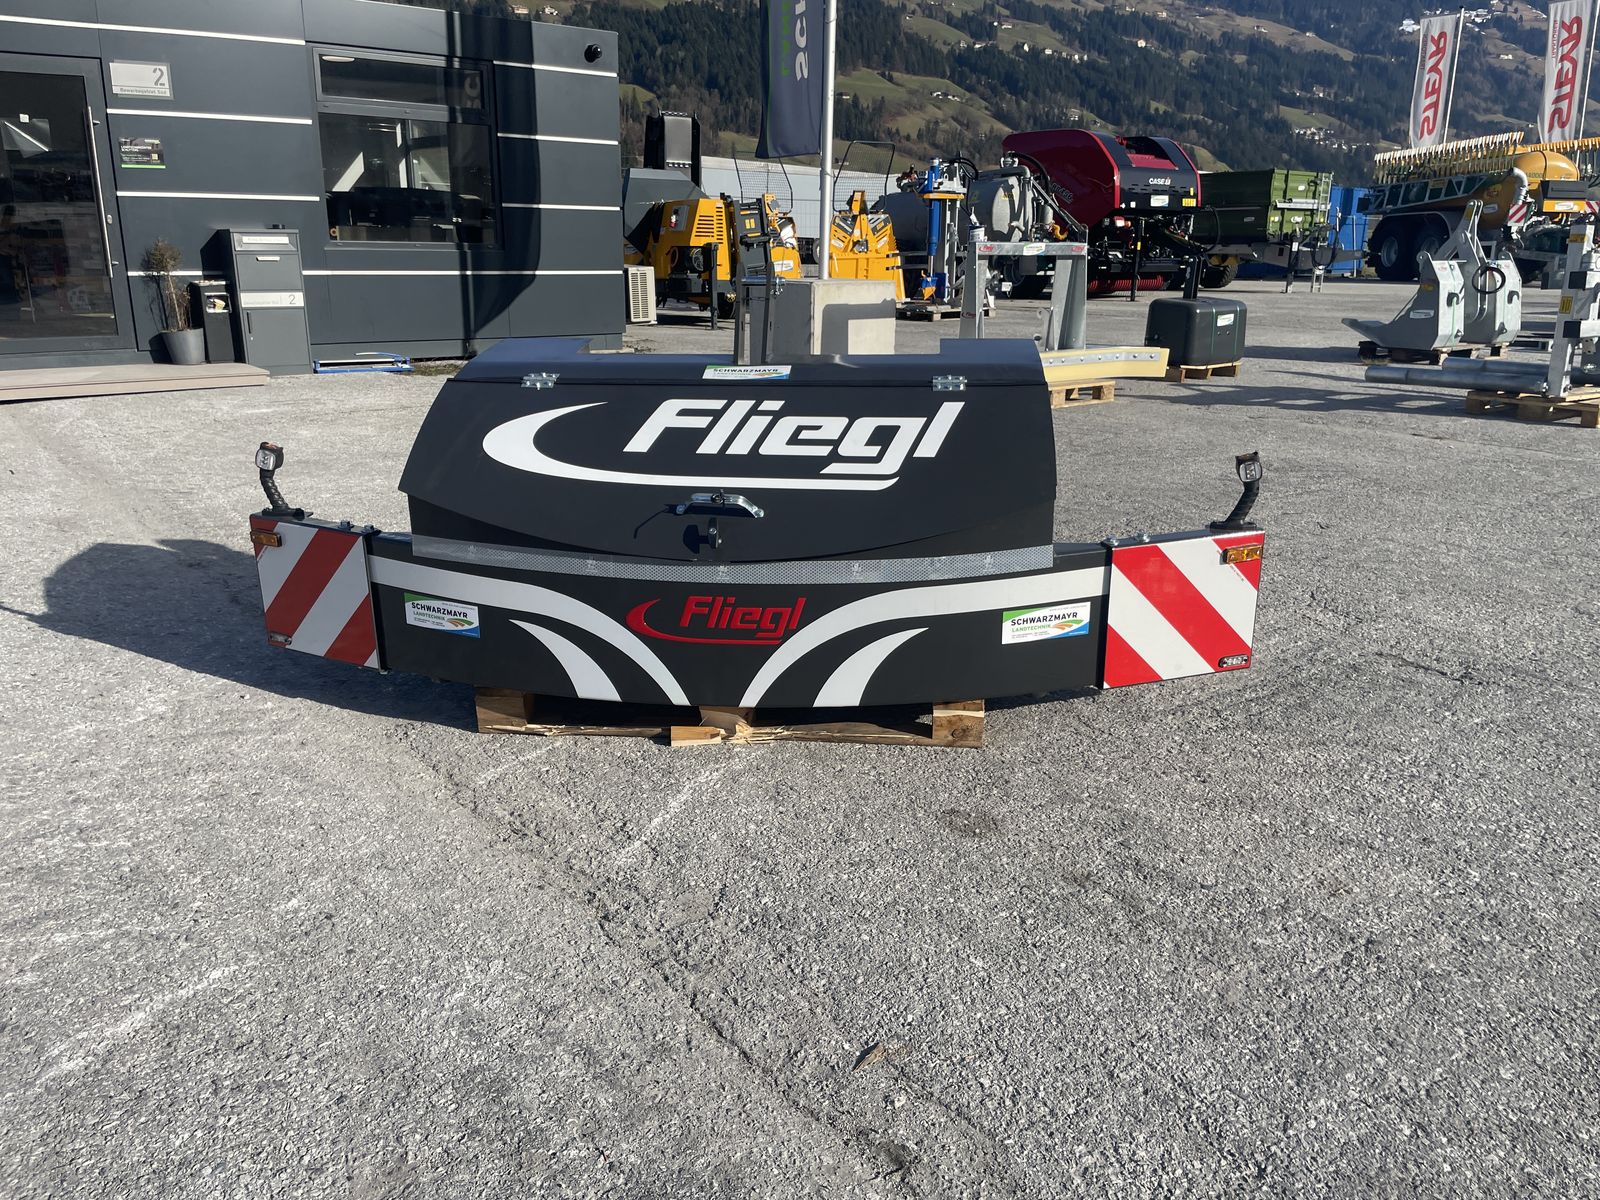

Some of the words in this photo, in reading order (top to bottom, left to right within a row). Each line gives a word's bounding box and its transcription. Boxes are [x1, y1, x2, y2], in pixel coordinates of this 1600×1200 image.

[152, 67, 166, 87] 2
[288, 294, 297, 305] 2
[622, 399, 966, 475] Fliegl
[411, 602, 468, 619] SCHWARZMAYR
[413, 611, 446, 621] LANDTECHNIK
[679, 596, 807, 638] Fliegl
[1010, 611, 1078, 626] SCHWARZMAYR
[1011, 623, 1051, 633] LANDTECHNIK
